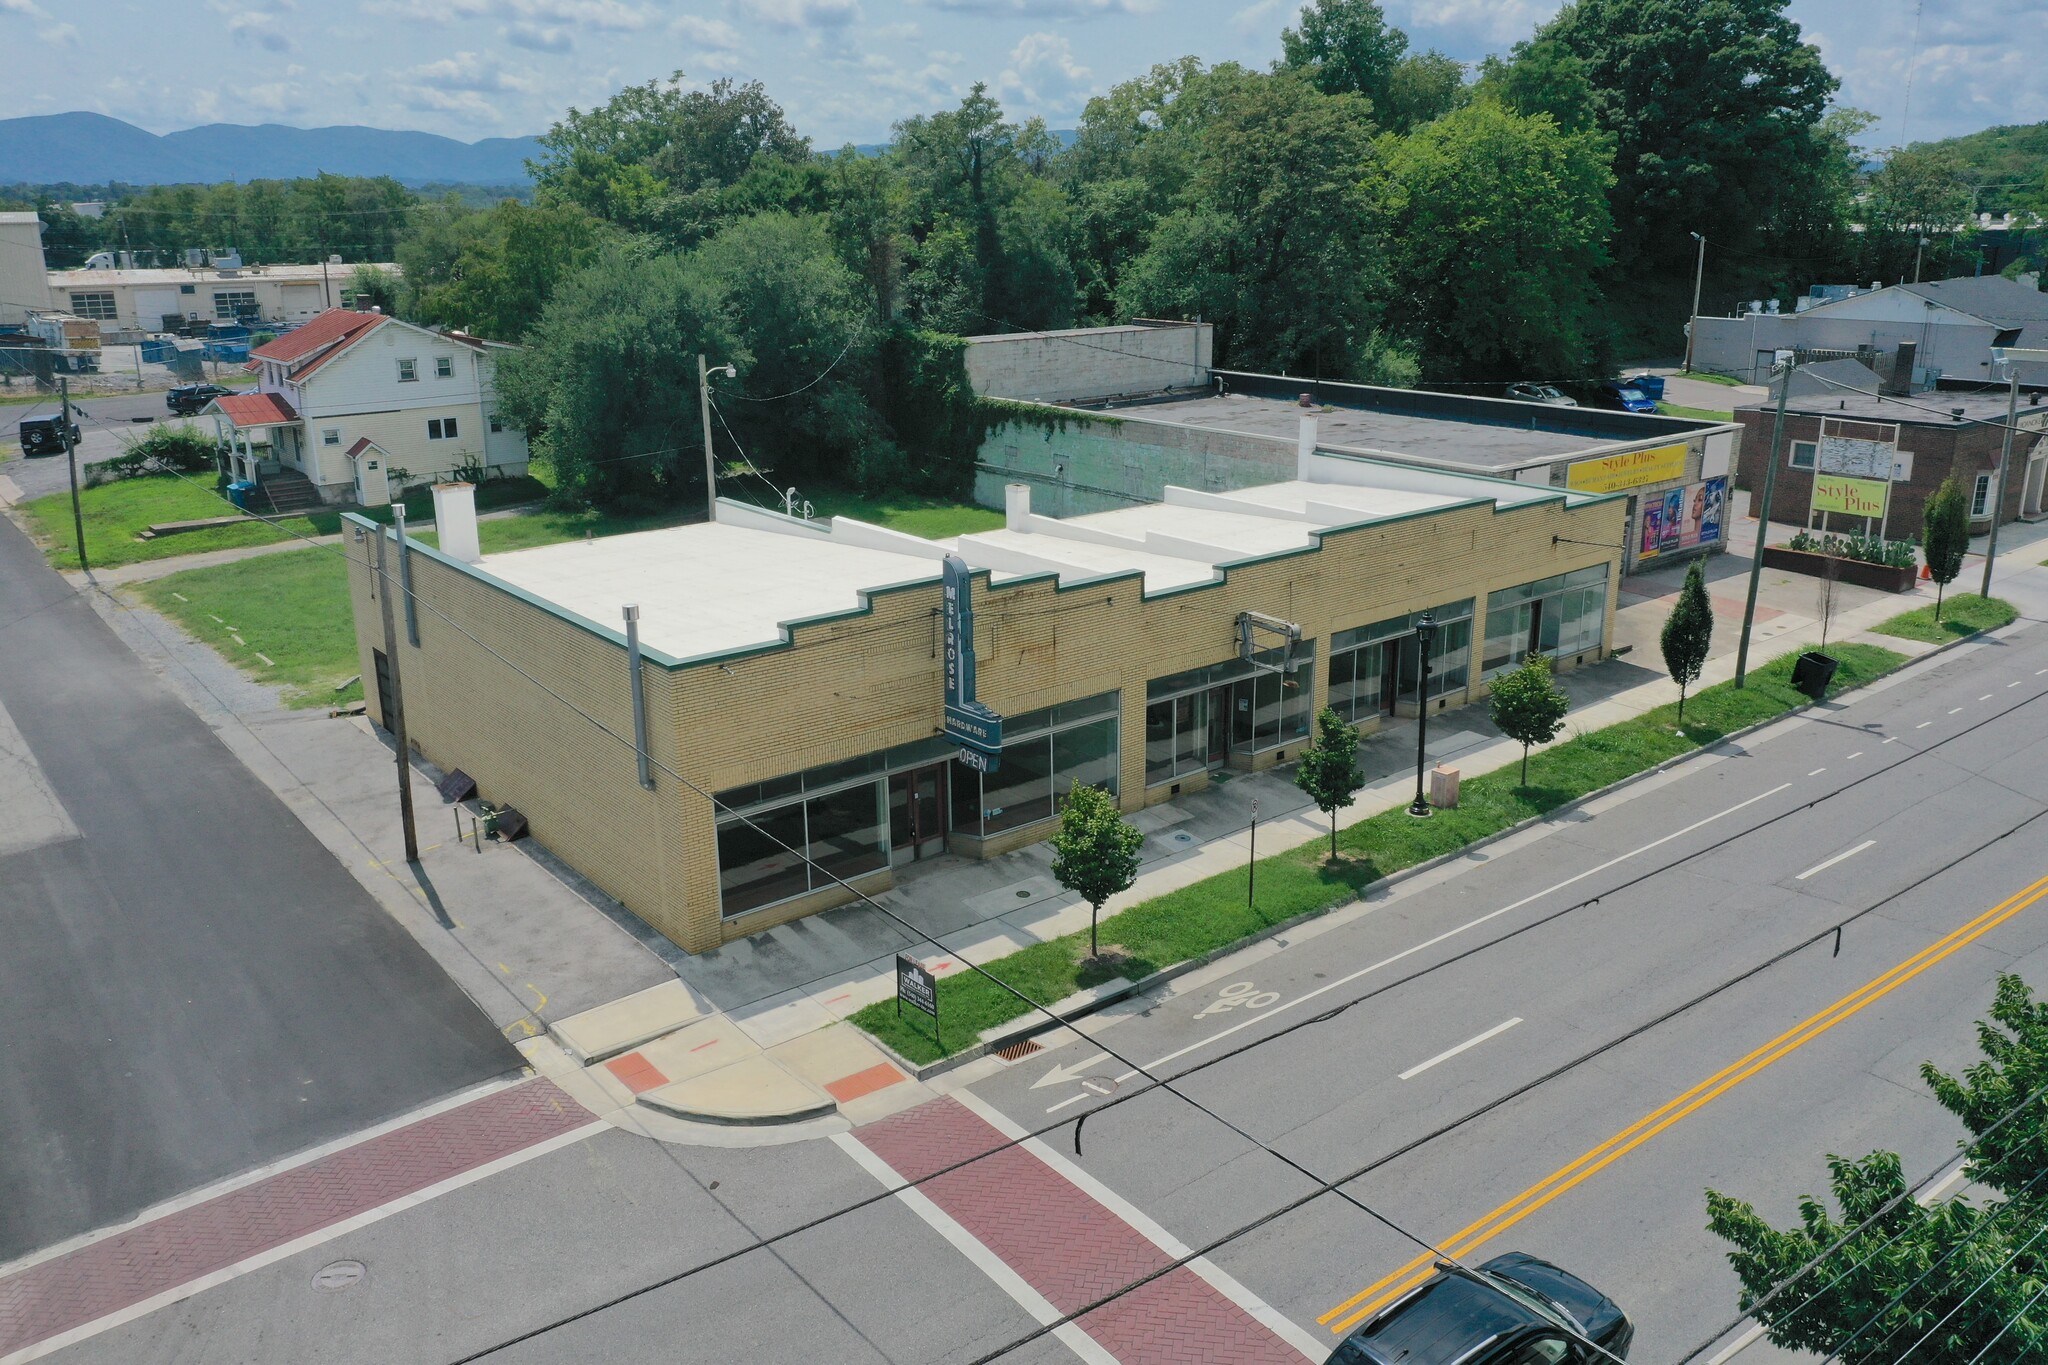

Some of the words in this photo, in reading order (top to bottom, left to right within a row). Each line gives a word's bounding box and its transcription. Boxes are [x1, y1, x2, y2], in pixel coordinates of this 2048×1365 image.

[1602, 456, 1630, 471] Style
[1633, 452, 1655, 465] Plus
[1817, 484, 1858, 500] Style
[1845, 497, 1880, 511] Plus
[945, 585, 956, 690] MELROSE
[946, 715, 987, 738] HARDWARE
[960, 747, 987, 772] OPEN
[903, 975, 930, 996] WALKER
